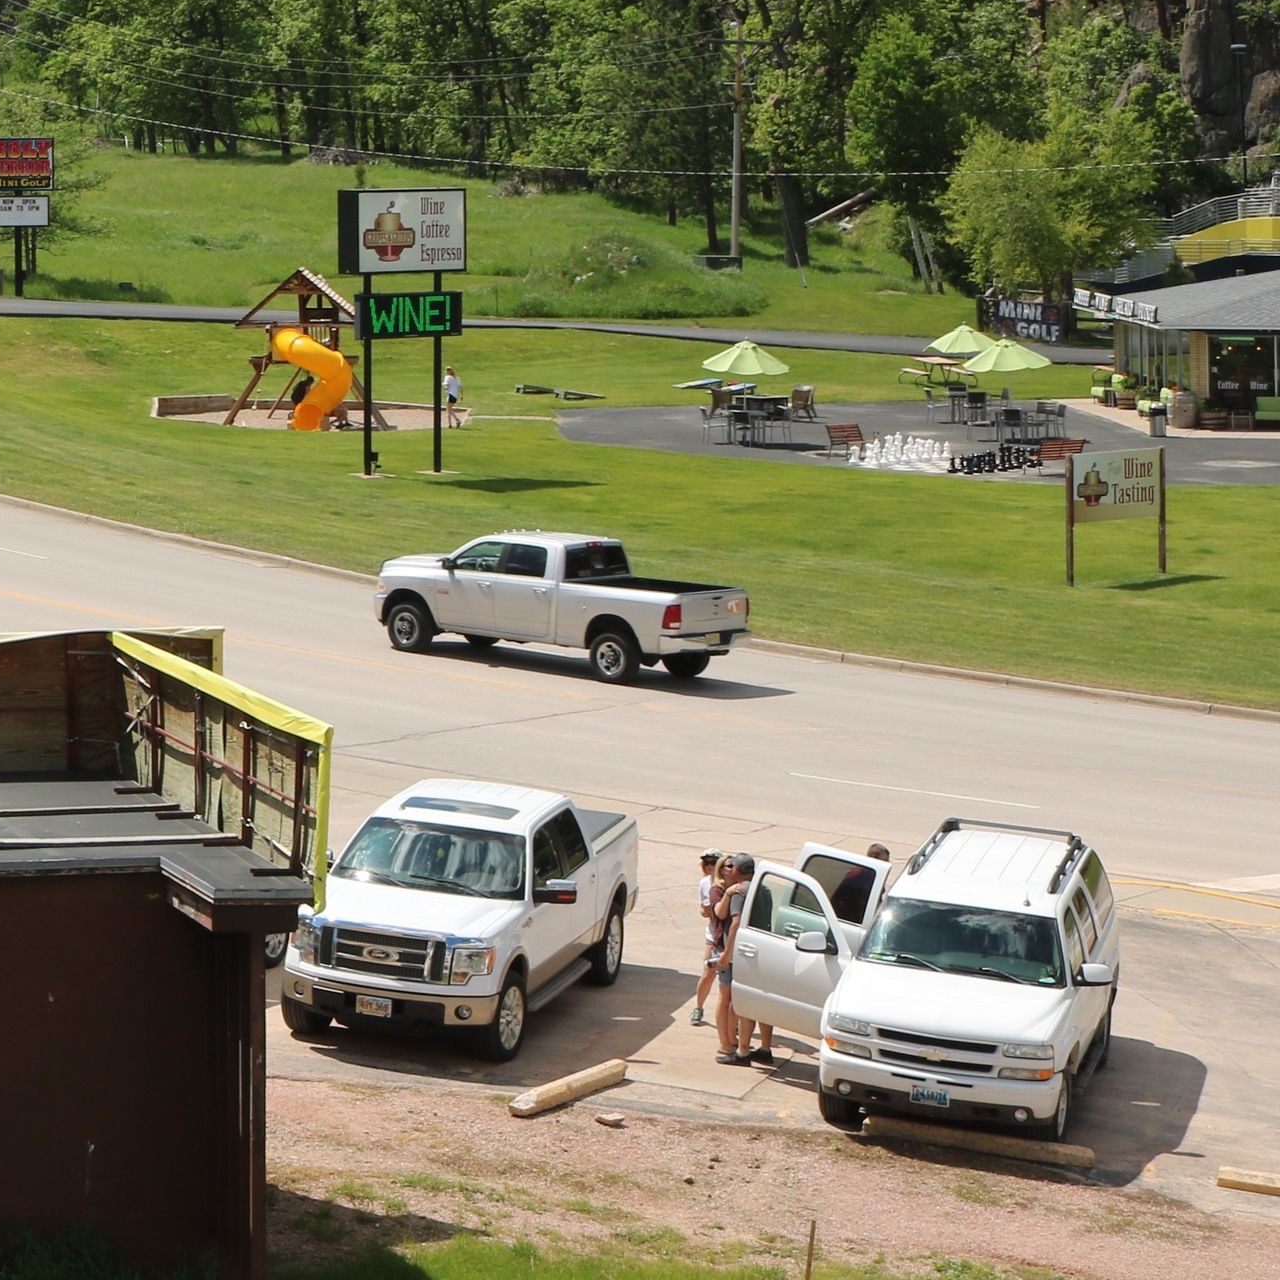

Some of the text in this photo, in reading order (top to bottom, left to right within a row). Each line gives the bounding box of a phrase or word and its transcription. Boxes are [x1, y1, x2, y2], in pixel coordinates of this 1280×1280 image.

[421, 197, 445, 215] Wine
[421, 220, 450, 238] Coffee
[421, 244, 462, 264] Espresso
[369, 295, 450, 334] WINE!
[999, 301, 1042, 320] MINI
[1016, 322, 1060, 341] GOLF
[1124, 458, 1153, 479] Wine
[1112, 482, 1155, 505] Tasting
